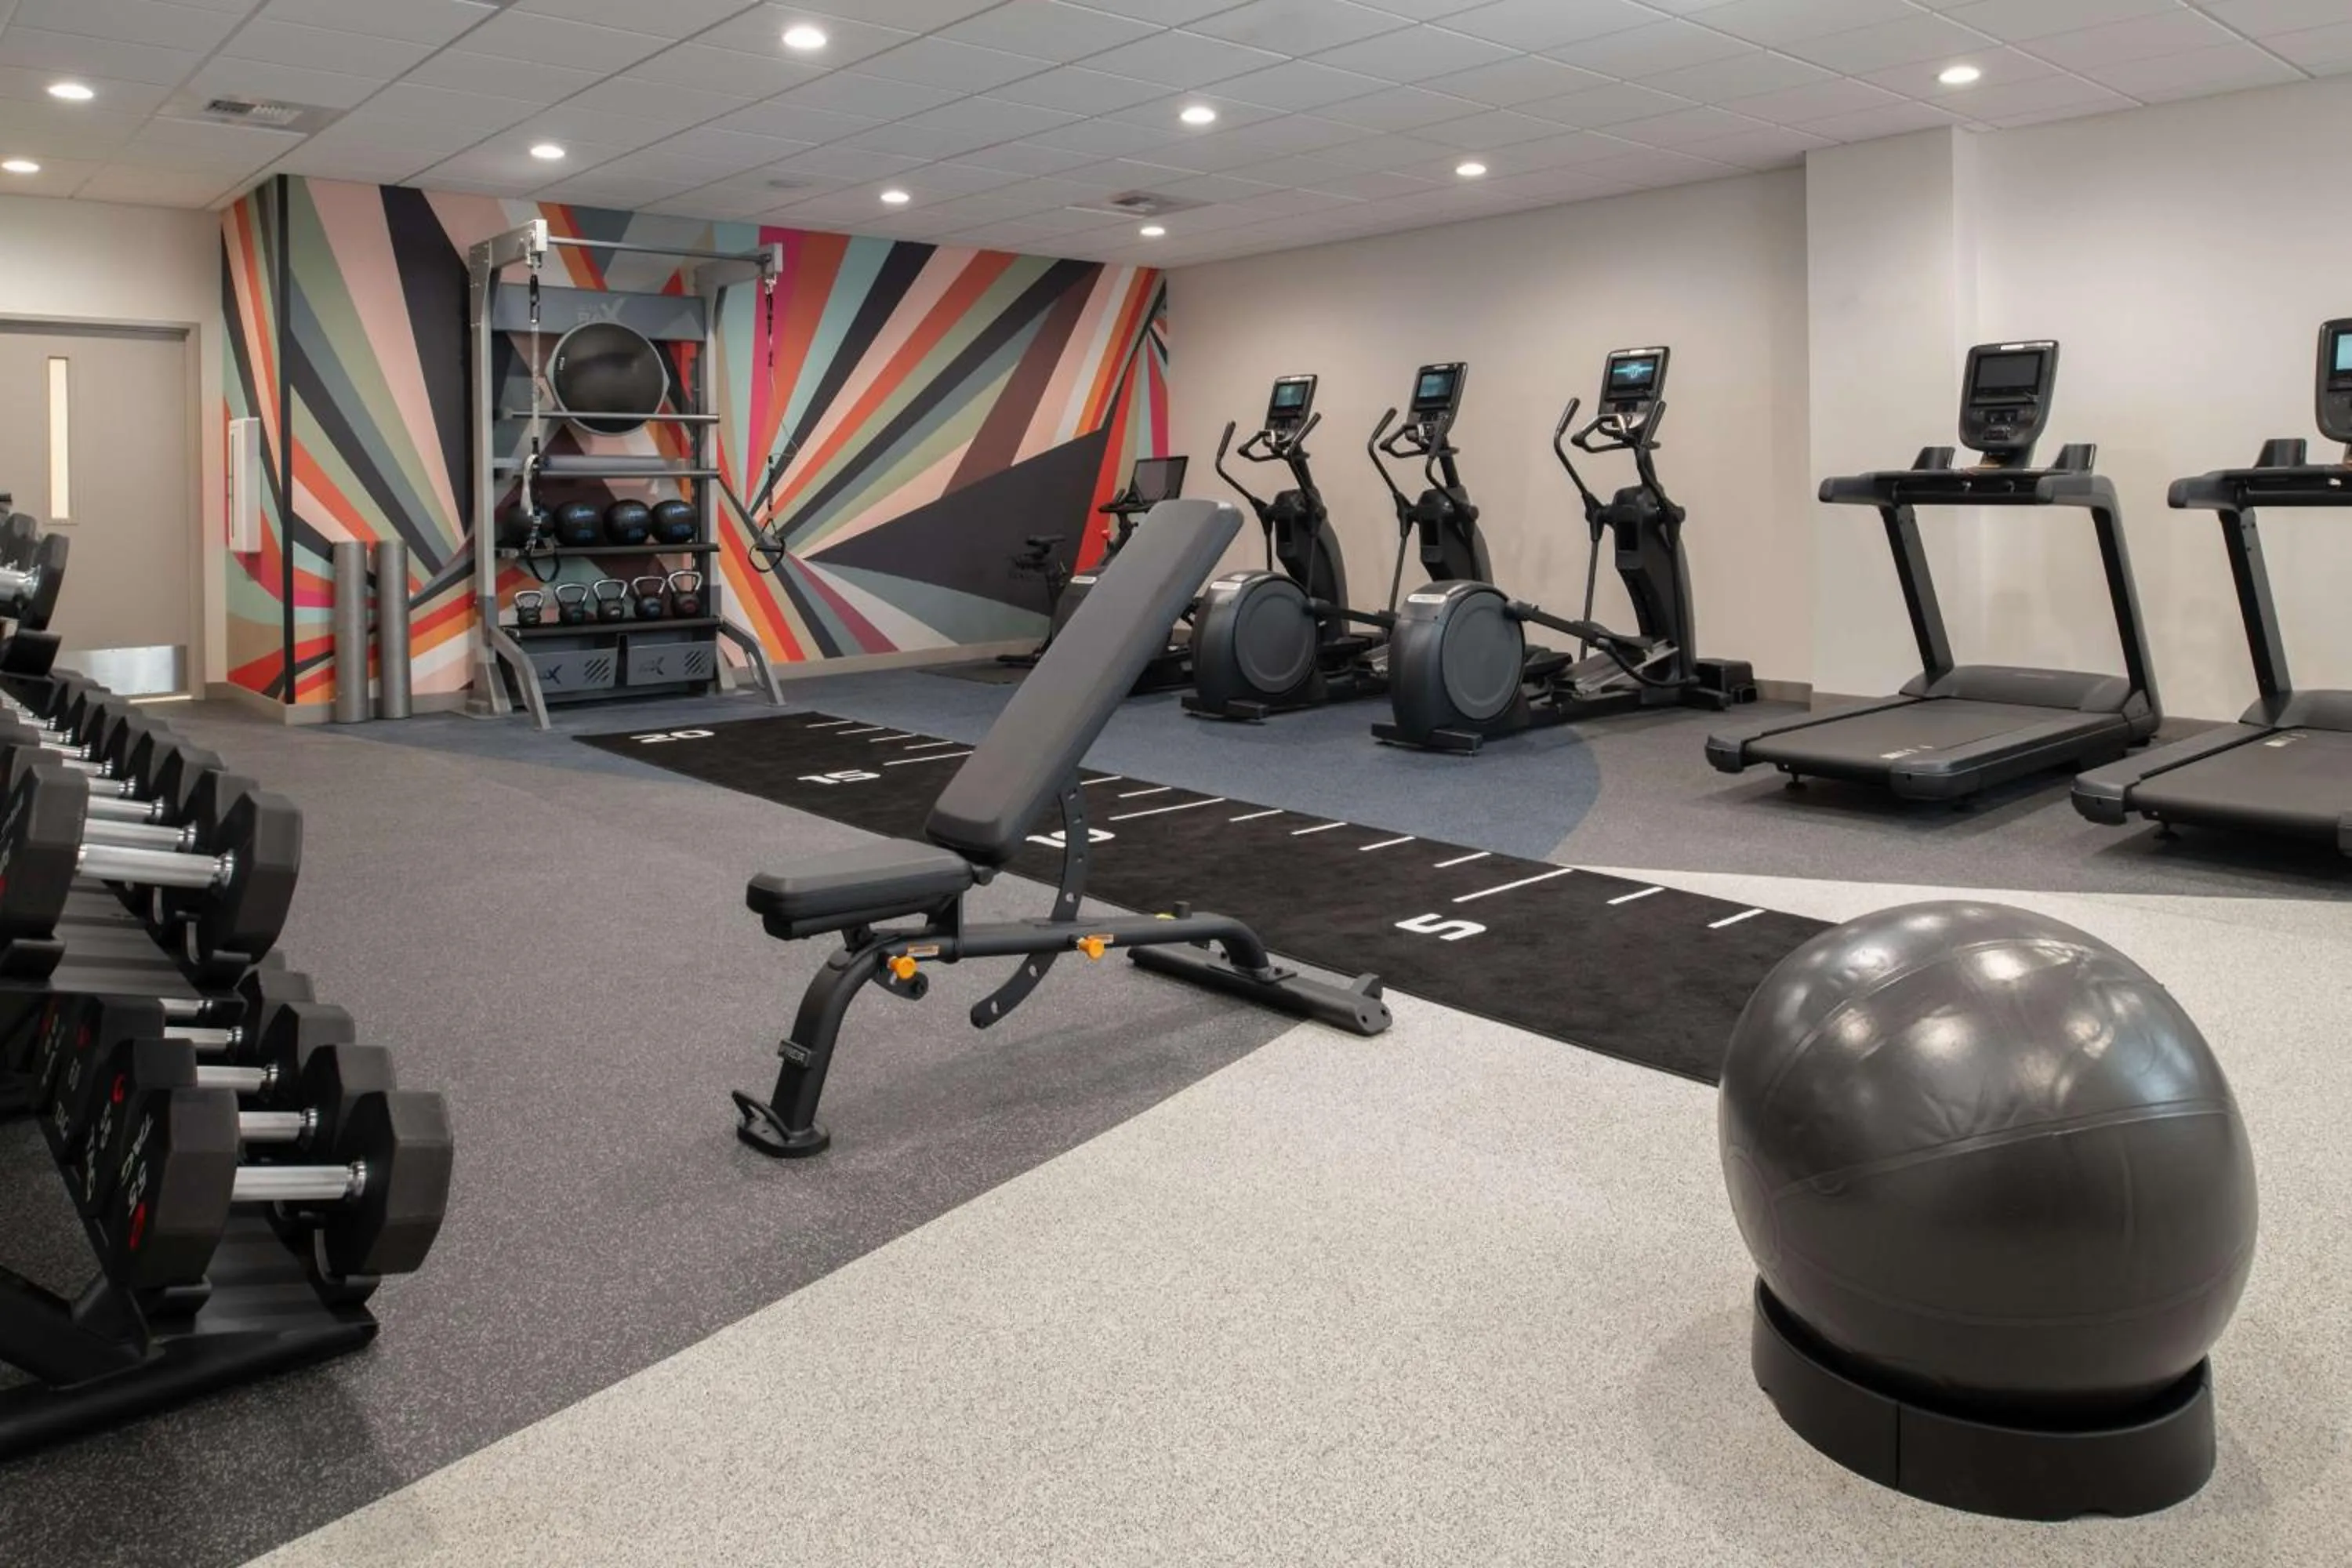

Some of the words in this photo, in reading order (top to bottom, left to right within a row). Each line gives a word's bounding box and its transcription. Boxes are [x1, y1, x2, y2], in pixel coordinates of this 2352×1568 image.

[630, 729, 715, 743] 20
[797, 769, 881, 785] 15
[1394, 913, 1487, 941] 5
